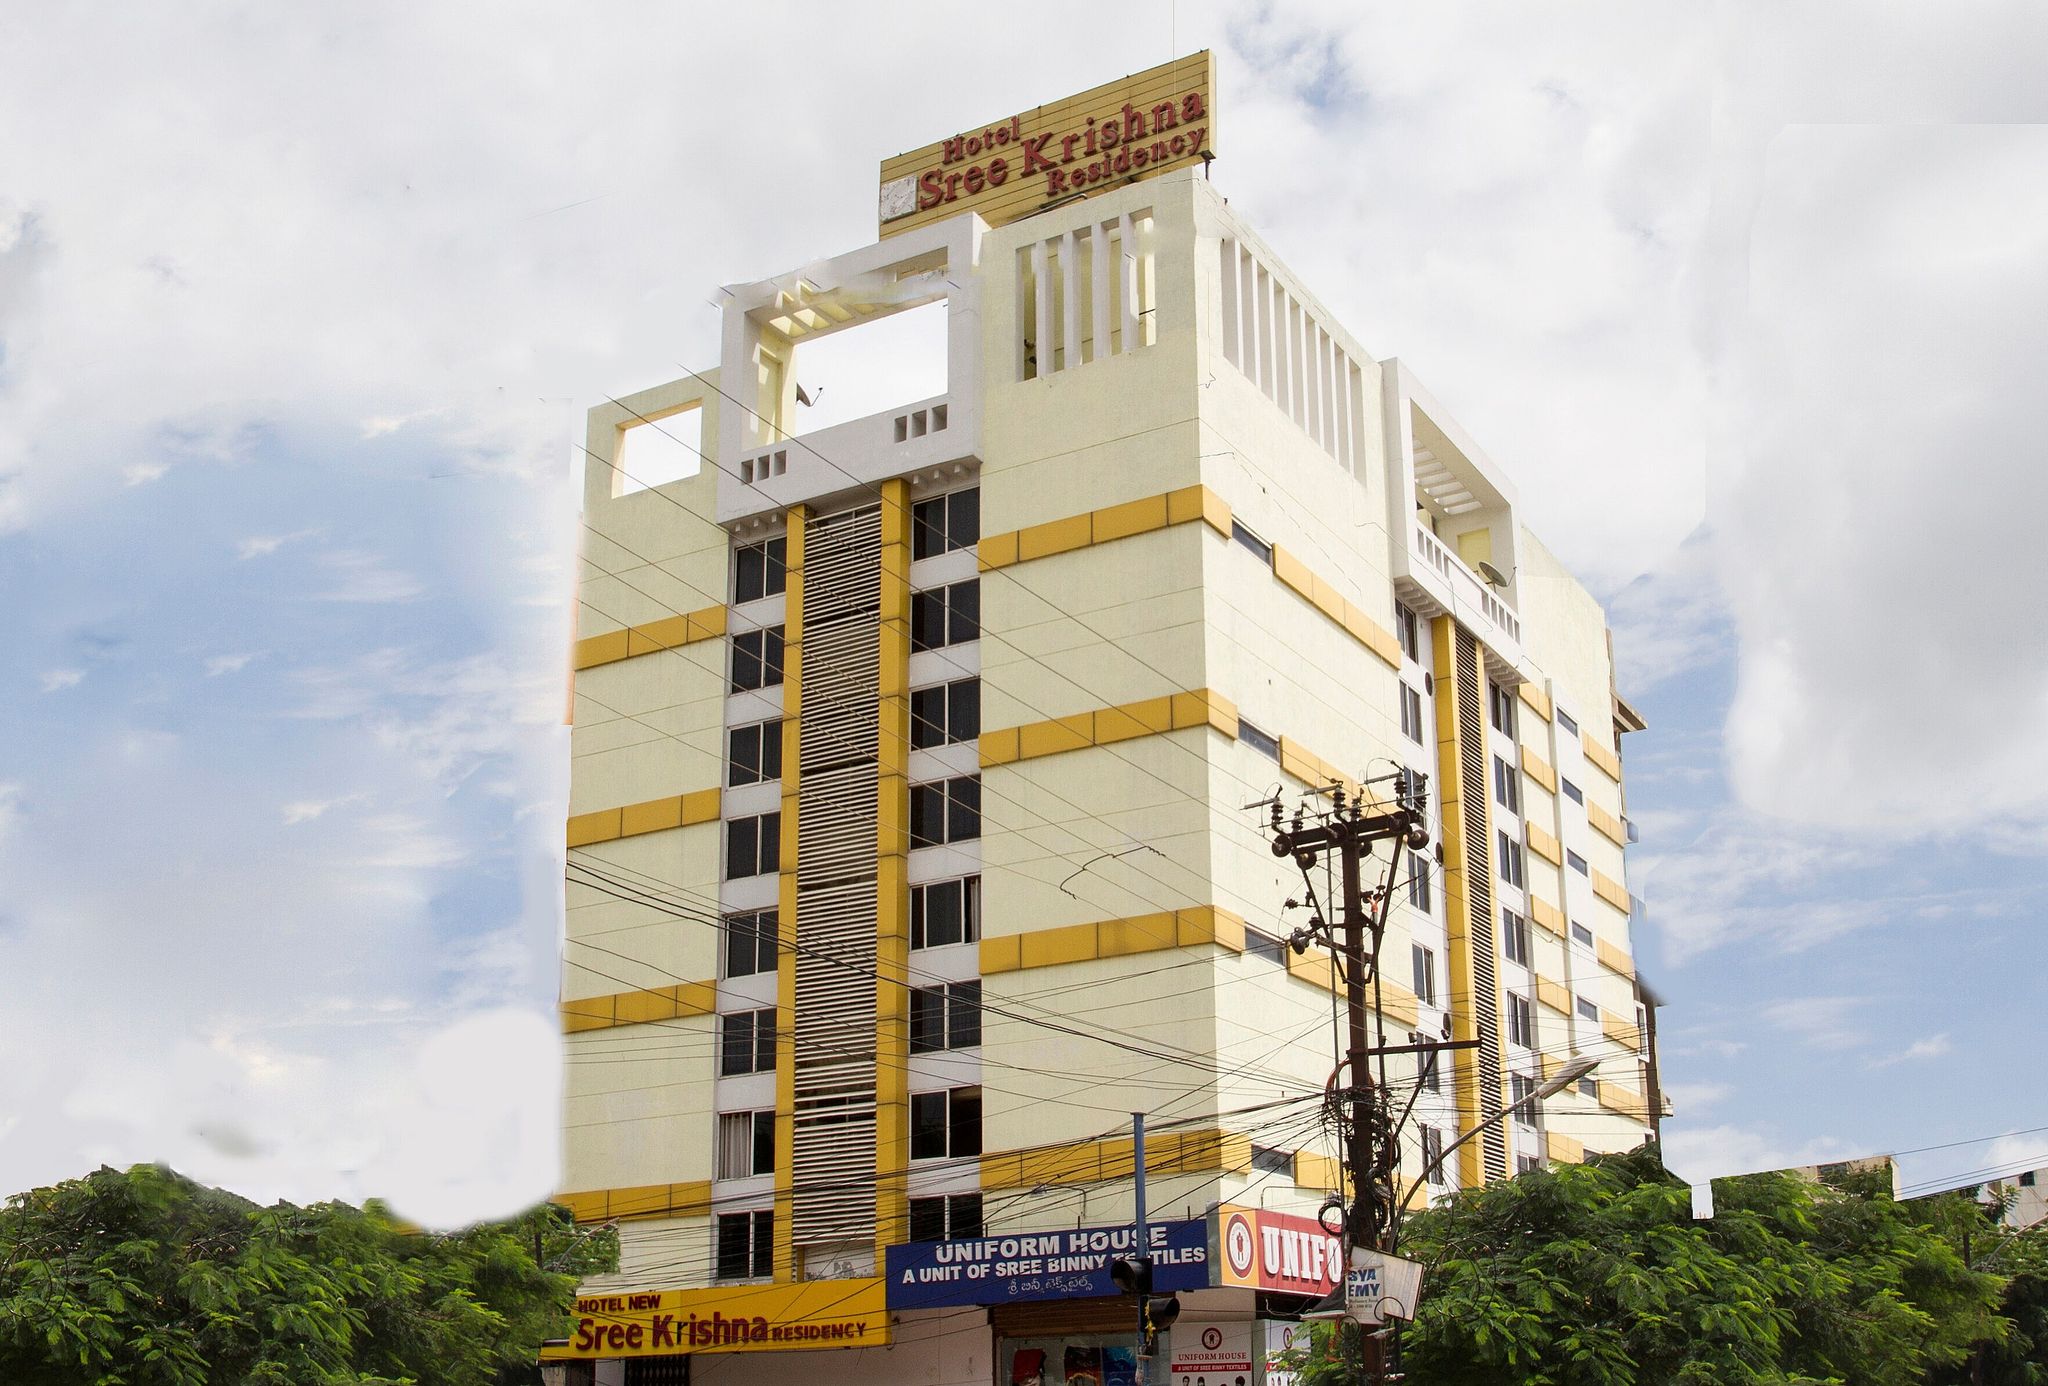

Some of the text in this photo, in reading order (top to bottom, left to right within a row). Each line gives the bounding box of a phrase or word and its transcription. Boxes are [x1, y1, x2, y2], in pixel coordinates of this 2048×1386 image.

[920, 91, 1206, 211] Sree Krishna
[942, 115, 1020, 165] Hotel
[1046, 126, 1207, 197] Residency
[935, 1235, 1060, 1263] UNIFORM
[902, 1269, 916, 1284] A
[919, 1265, 962, 1282] UNIT
[967, 1263, 989, 1279] OF
[995, 1259, 1042, 1277] SREE
[1048, 1253, 1106, 1274] BINNY
[578, 1295, 661, 1313] HOTEL NEW
[575, 1311, 866, 1350] Sree Krishna RESIDENCY
[1178, 1352, 1247, 1361] UNIFORM HOUSE
